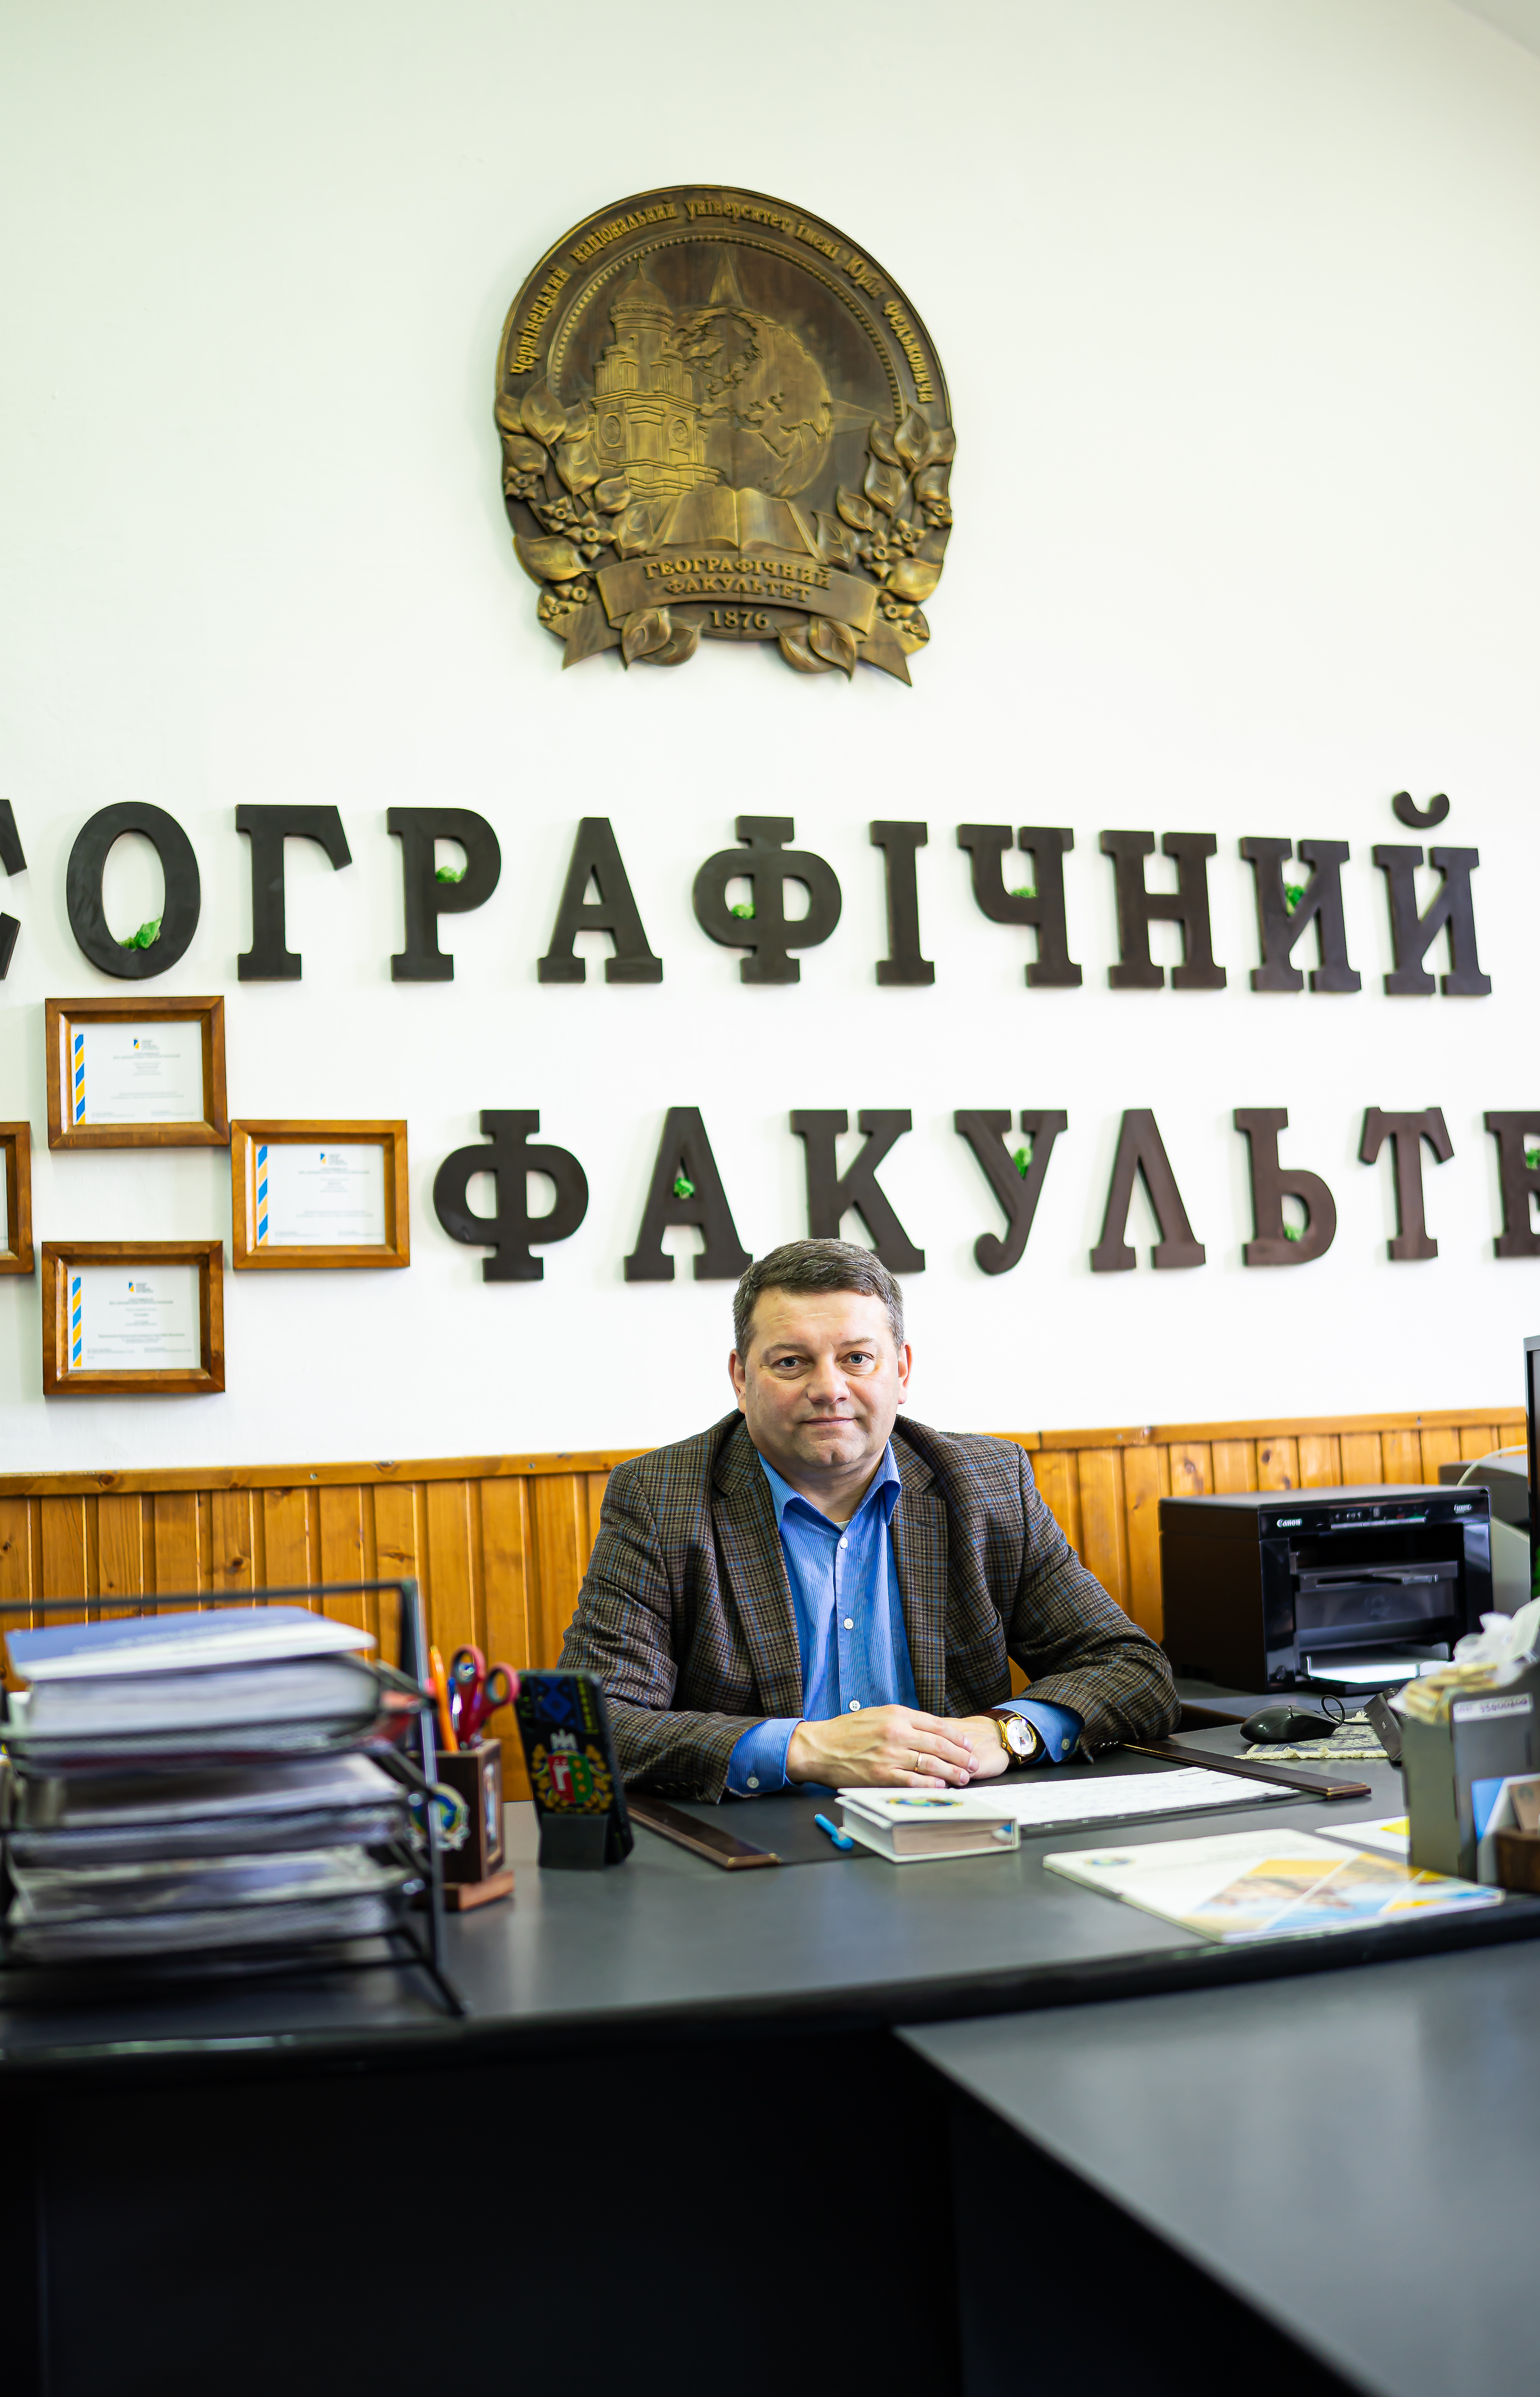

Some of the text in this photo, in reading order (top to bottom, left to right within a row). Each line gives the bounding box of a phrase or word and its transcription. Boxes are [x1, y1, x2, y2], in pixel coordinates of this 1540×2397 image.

[643, 558, 832, 590] ГЕОГРАФІЧНИЙ
[665, 577, 811, 602] ФАКУЛЬТЕТ
[710, 610, 769, 630] 1876
[1277, 1518, 1302, 1527] Canon
